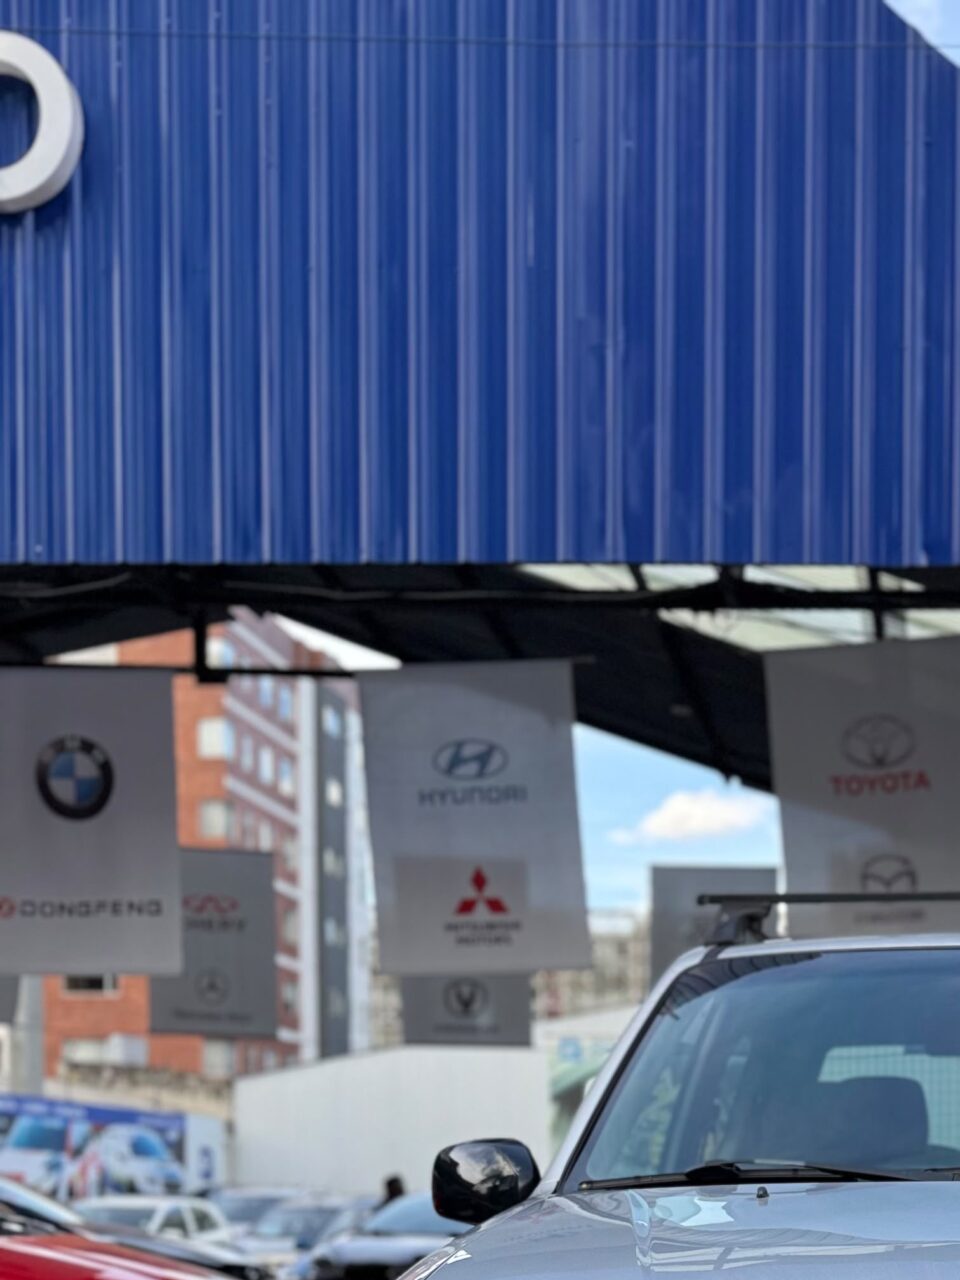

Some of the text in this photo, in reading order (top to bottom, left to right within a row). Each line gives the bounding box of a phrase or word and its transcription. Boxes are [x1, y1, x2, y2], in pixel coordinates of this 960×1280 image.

[830, 770, 931, 797] TOYOTA
[417, 784, 528, 807] HYUNDAI
[19, 899, 163, 918] DONGFENG
